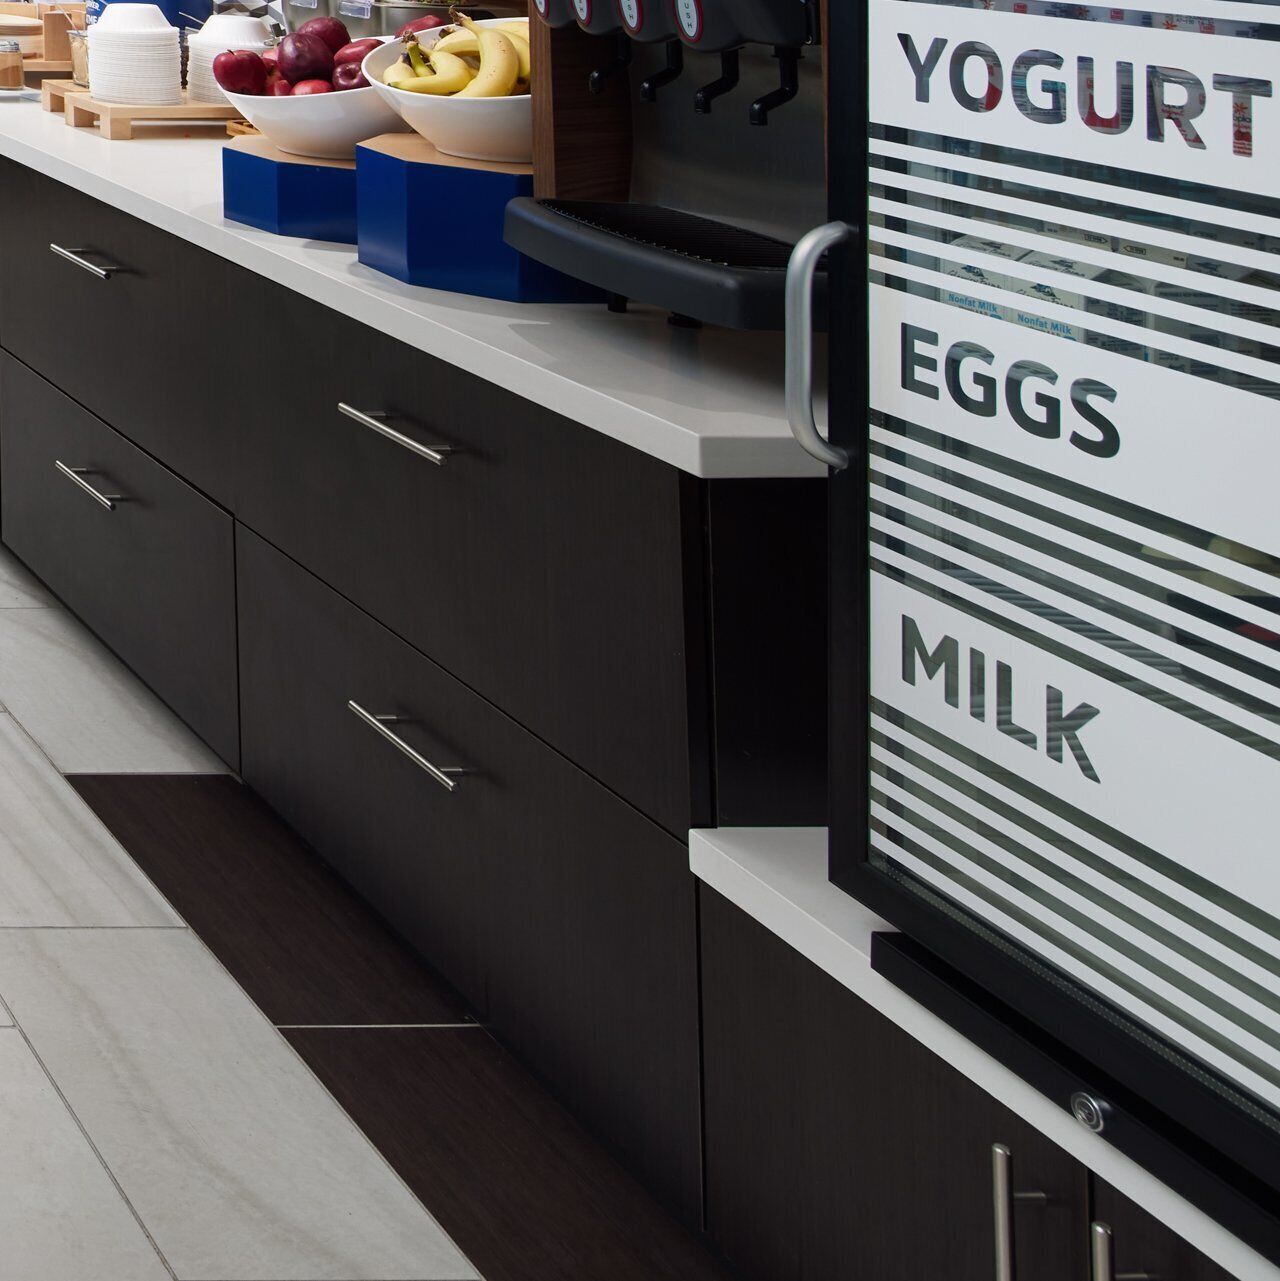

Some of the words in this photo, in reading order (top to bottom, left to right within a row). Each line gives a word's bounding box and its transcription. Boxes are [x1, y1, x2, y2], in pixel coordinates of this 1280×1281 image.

[896, 32, 1273, 158] YOGURT
[948, 293, 976, 308] Nonfat
[977, 301, 998, 313] Milk
[1017, 311, 1049, 329] Nonfat
[1050, 321, 1072, 335] Milk
[900, 321, 1121, 460] EGGS
[900, 612, 1103, 785] MILK
